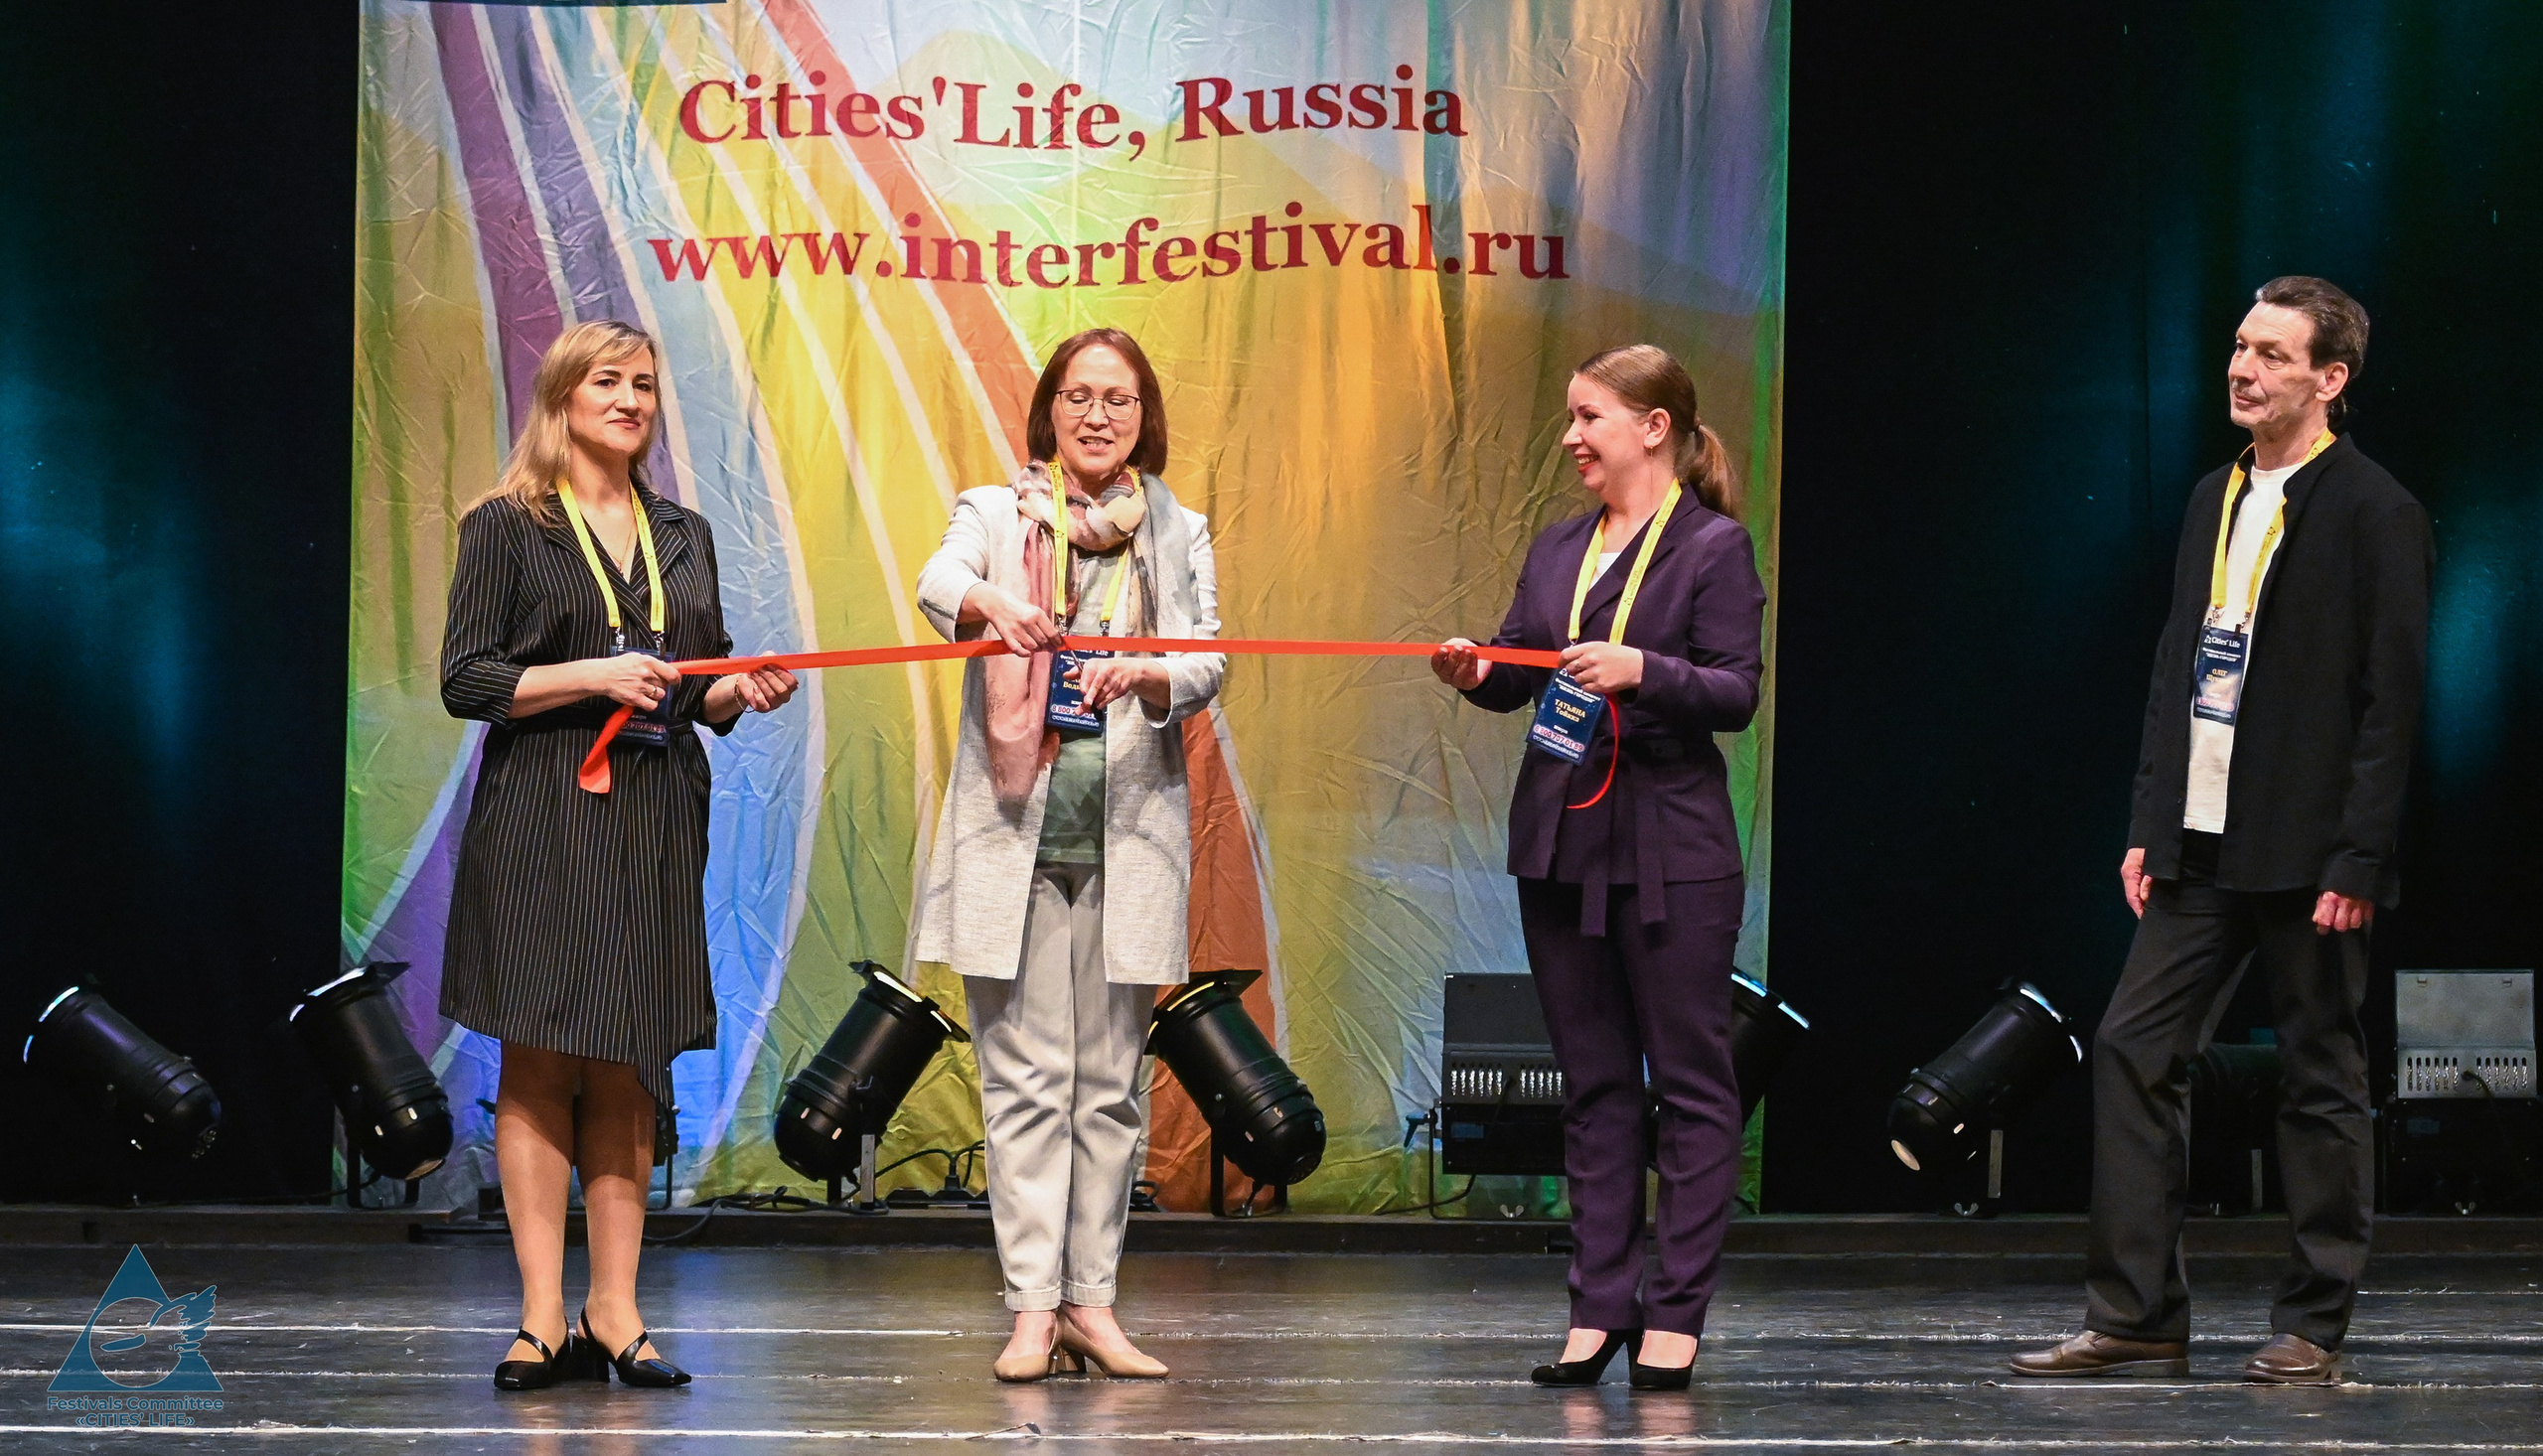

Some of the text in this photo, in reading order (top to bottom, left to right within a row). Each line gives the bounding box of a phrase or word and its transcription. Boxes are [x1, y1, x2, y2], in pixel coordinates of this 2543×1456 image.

[1176, 65, 1469, 142] Russia
[647, 202, 1571, 288] www.interfestival.ru
[1555, 699, 1586, 718] ТАТЬЯНА
[1552, 733, 1565, 742] 707
